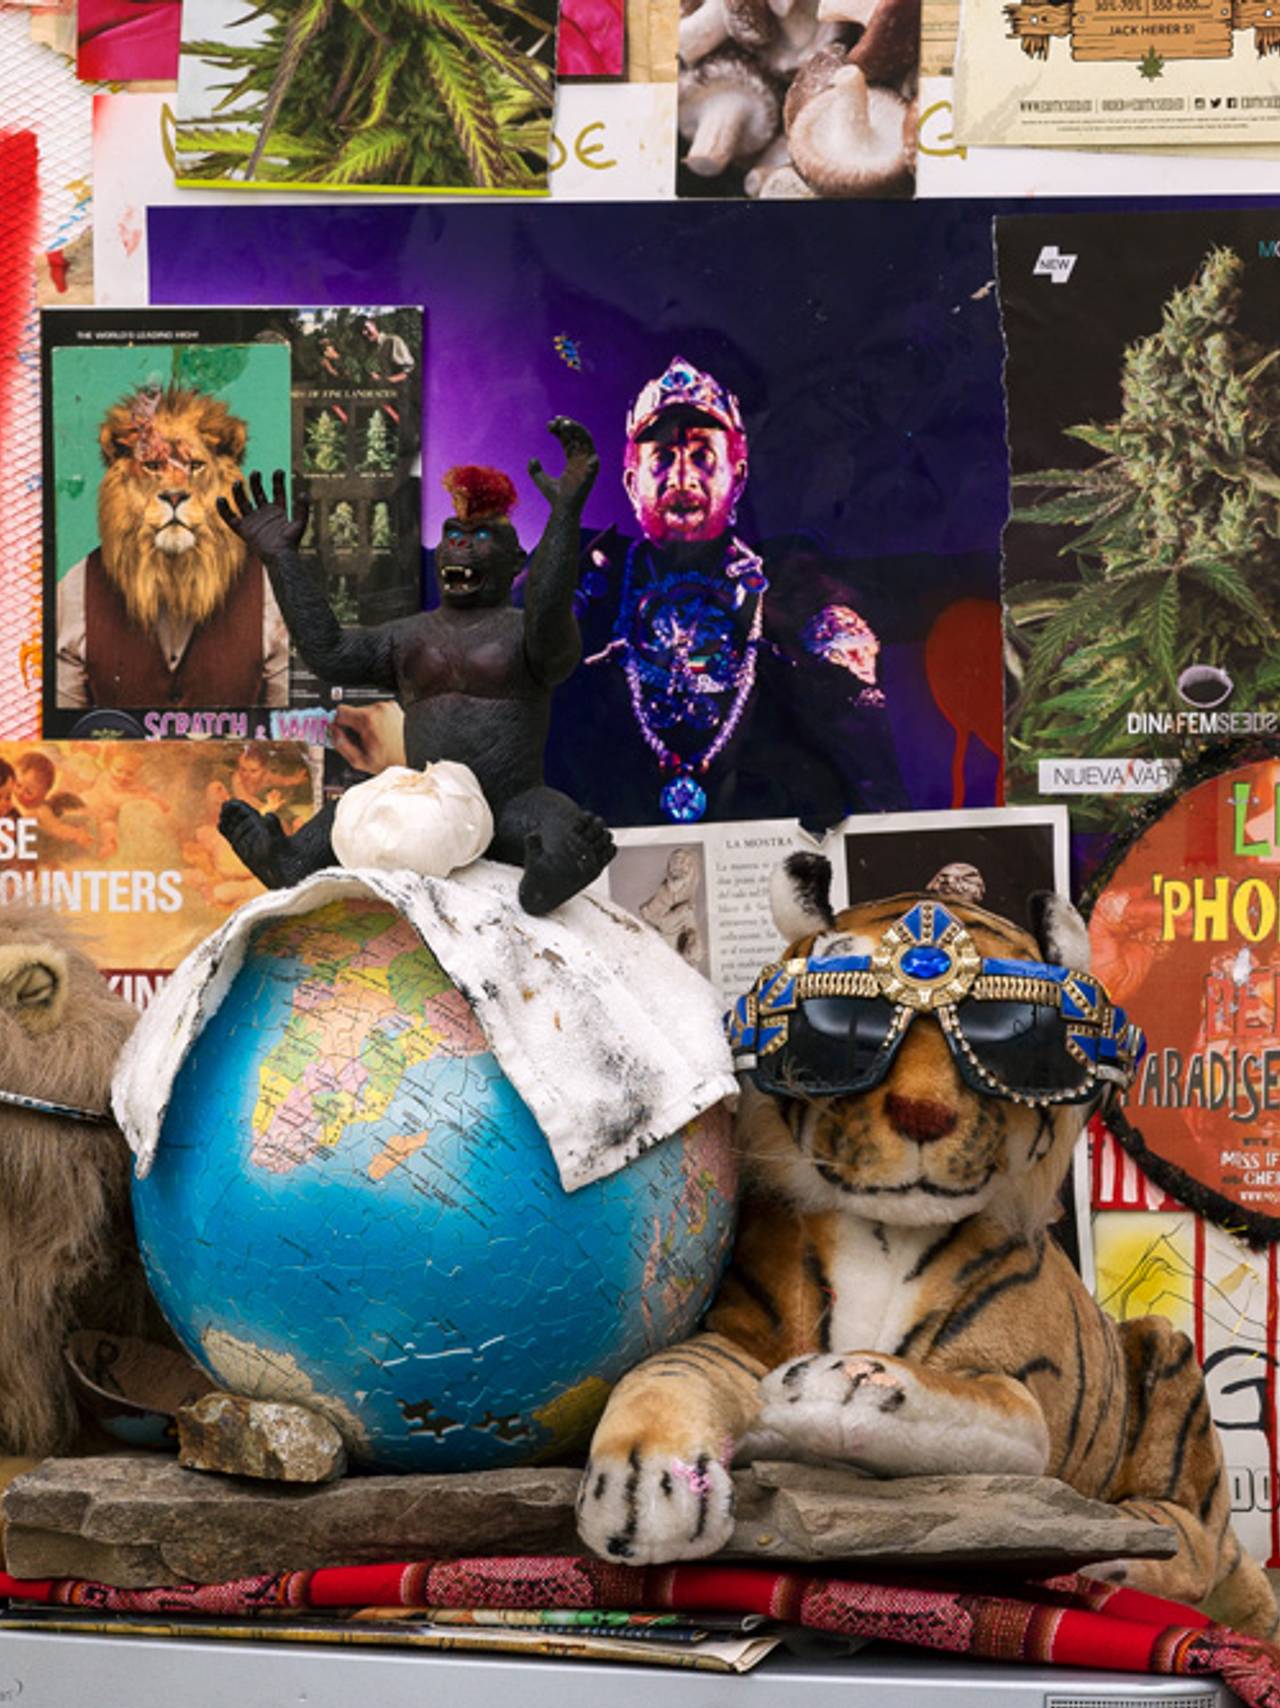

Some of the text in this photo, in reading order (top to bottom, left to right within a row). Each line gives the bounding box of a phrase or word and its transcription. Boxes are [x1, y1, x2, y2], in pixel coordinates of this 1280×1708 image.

[1109, 25, 1178, 37] JACK HERER
[1040, 257, 1071, 271] NEW
[144, 711, 248, 740] SCRATCH
[1054, 767, 1126, 786] NUEVA
[726, 837, 793, 849] LA MOSTRA
[1221, 1151, 1260, 1168] MISS
